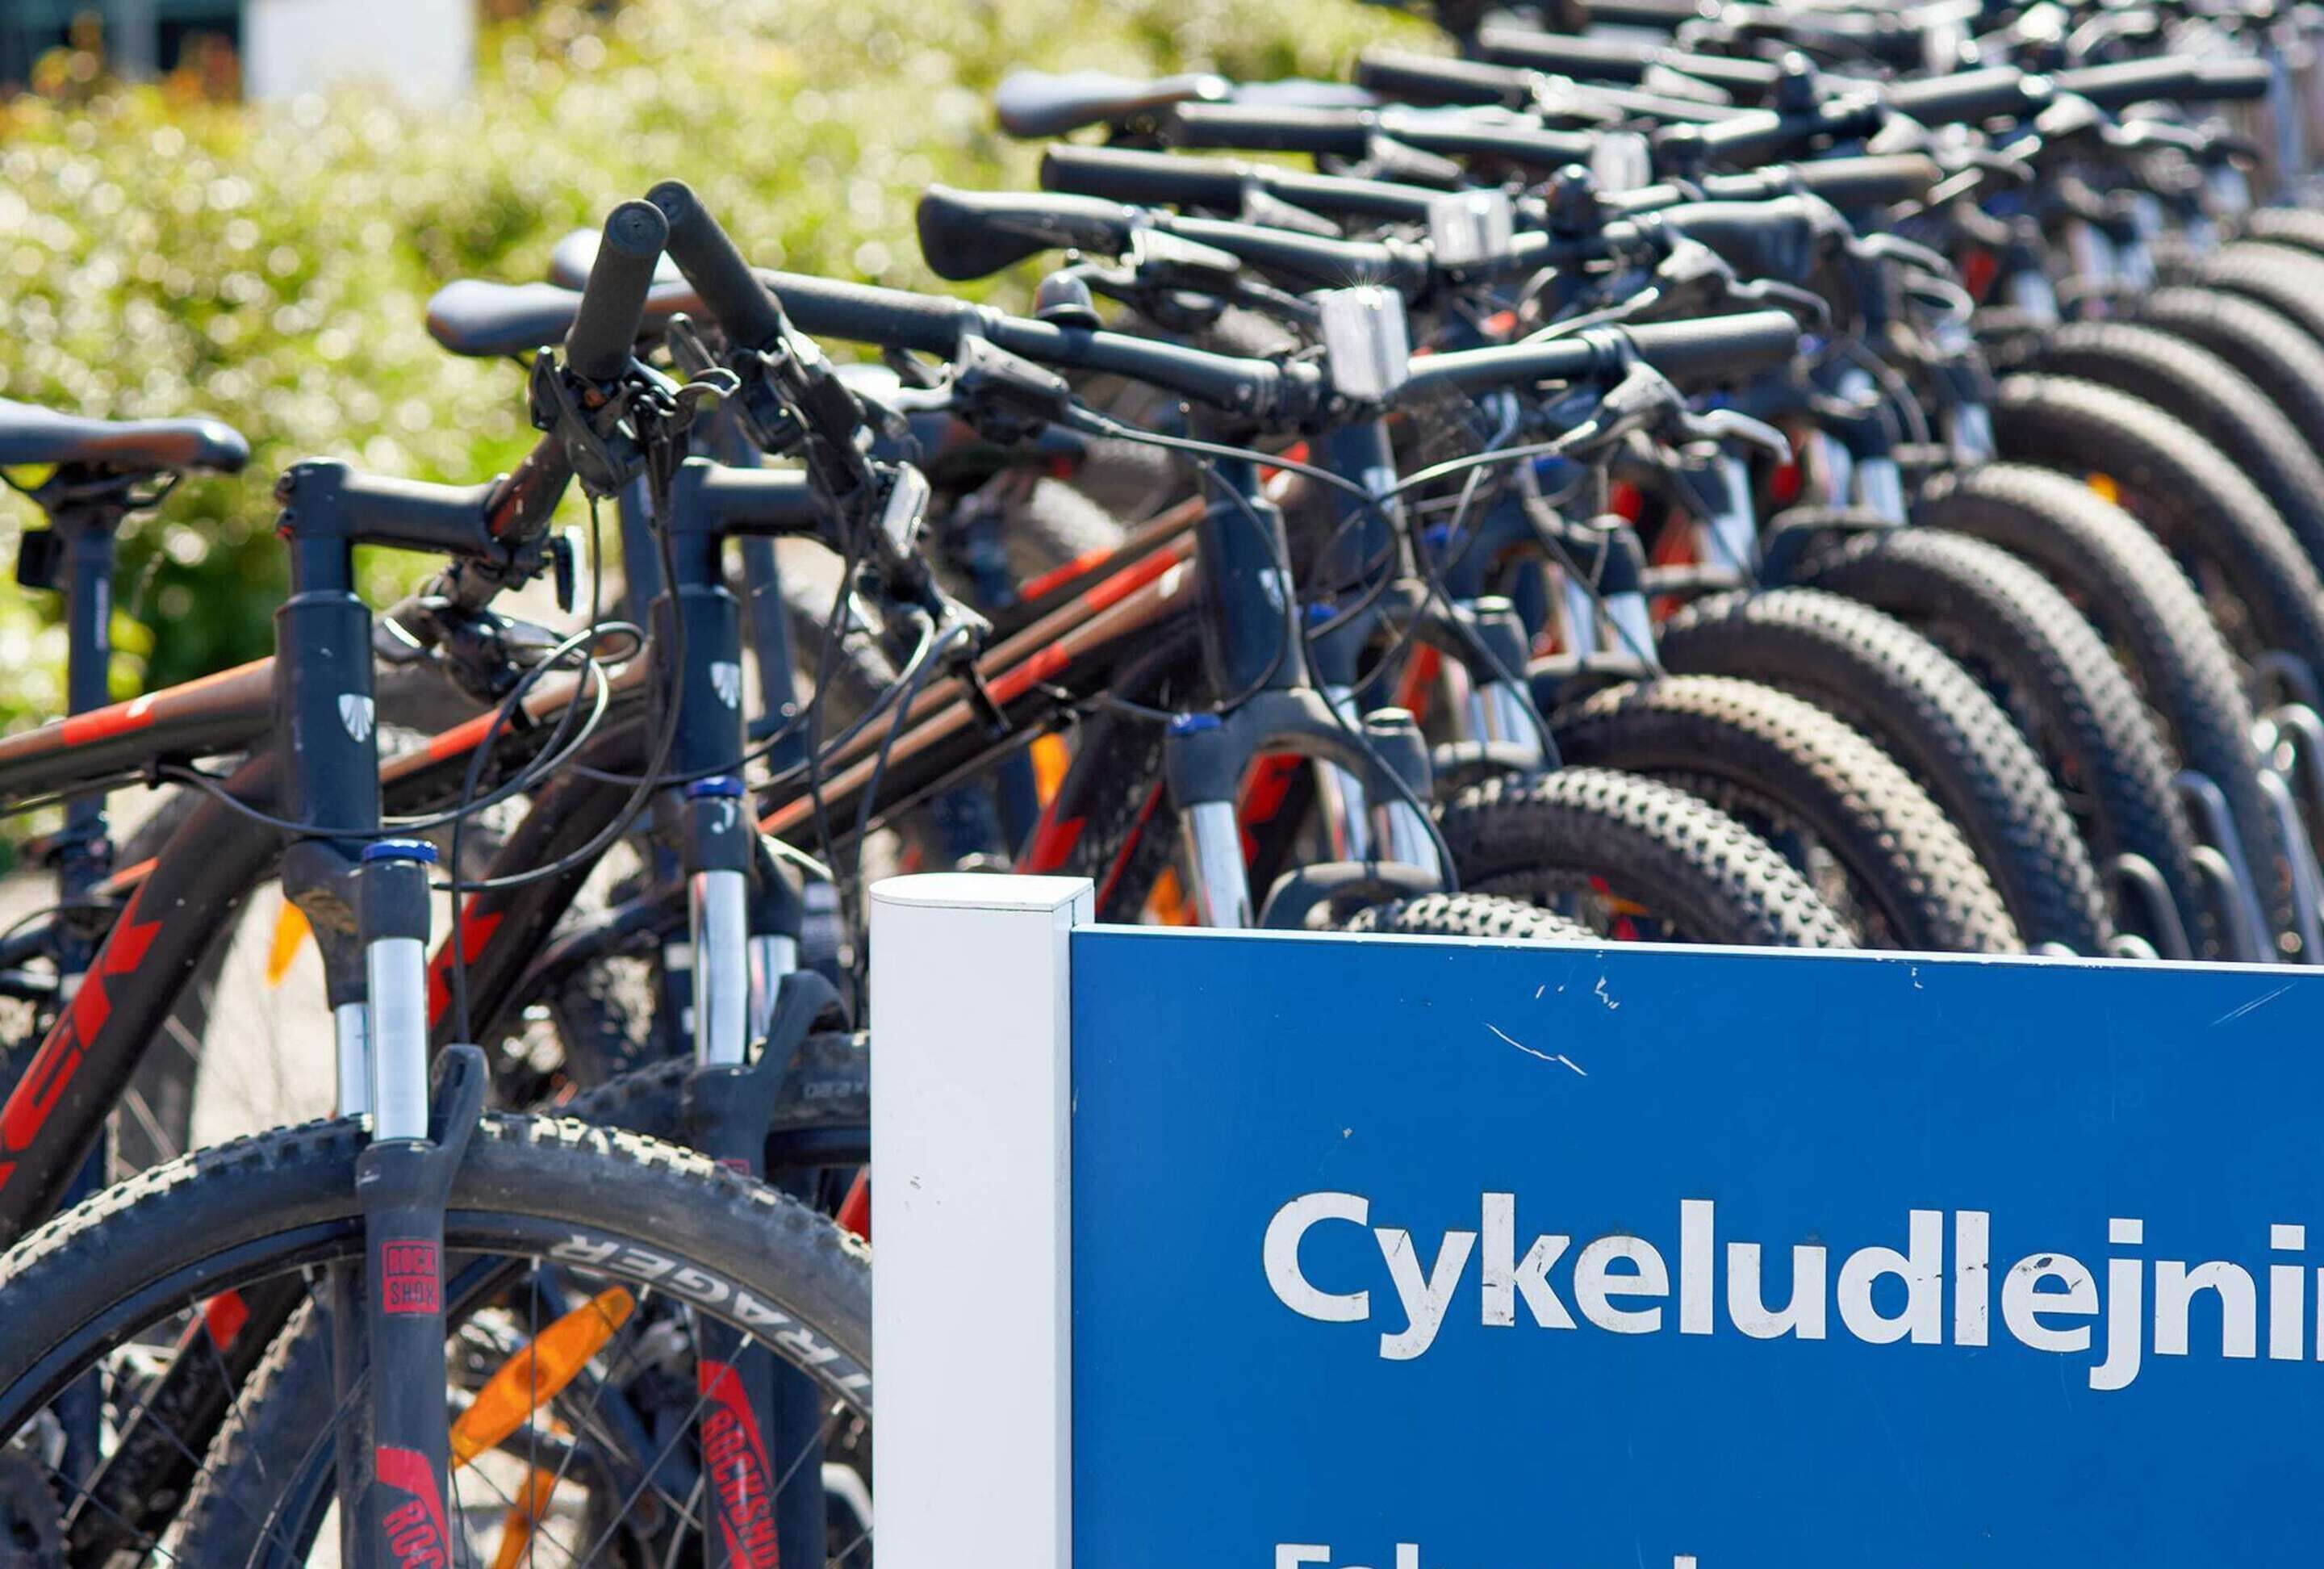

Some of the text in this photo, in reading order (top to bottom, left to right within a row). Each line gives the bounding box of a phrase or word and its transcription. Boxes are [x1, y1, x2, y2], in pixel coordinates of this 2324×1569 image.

[0, 878, 161, 1191] EK
[387, 1247, 434, 1274] ROCK
[390, 1280, 435, 1306] SHOX
[550, 1234, 872, 1414] TRAGER
[1263, 1191, 2324, 1391] Cykeludlejni
